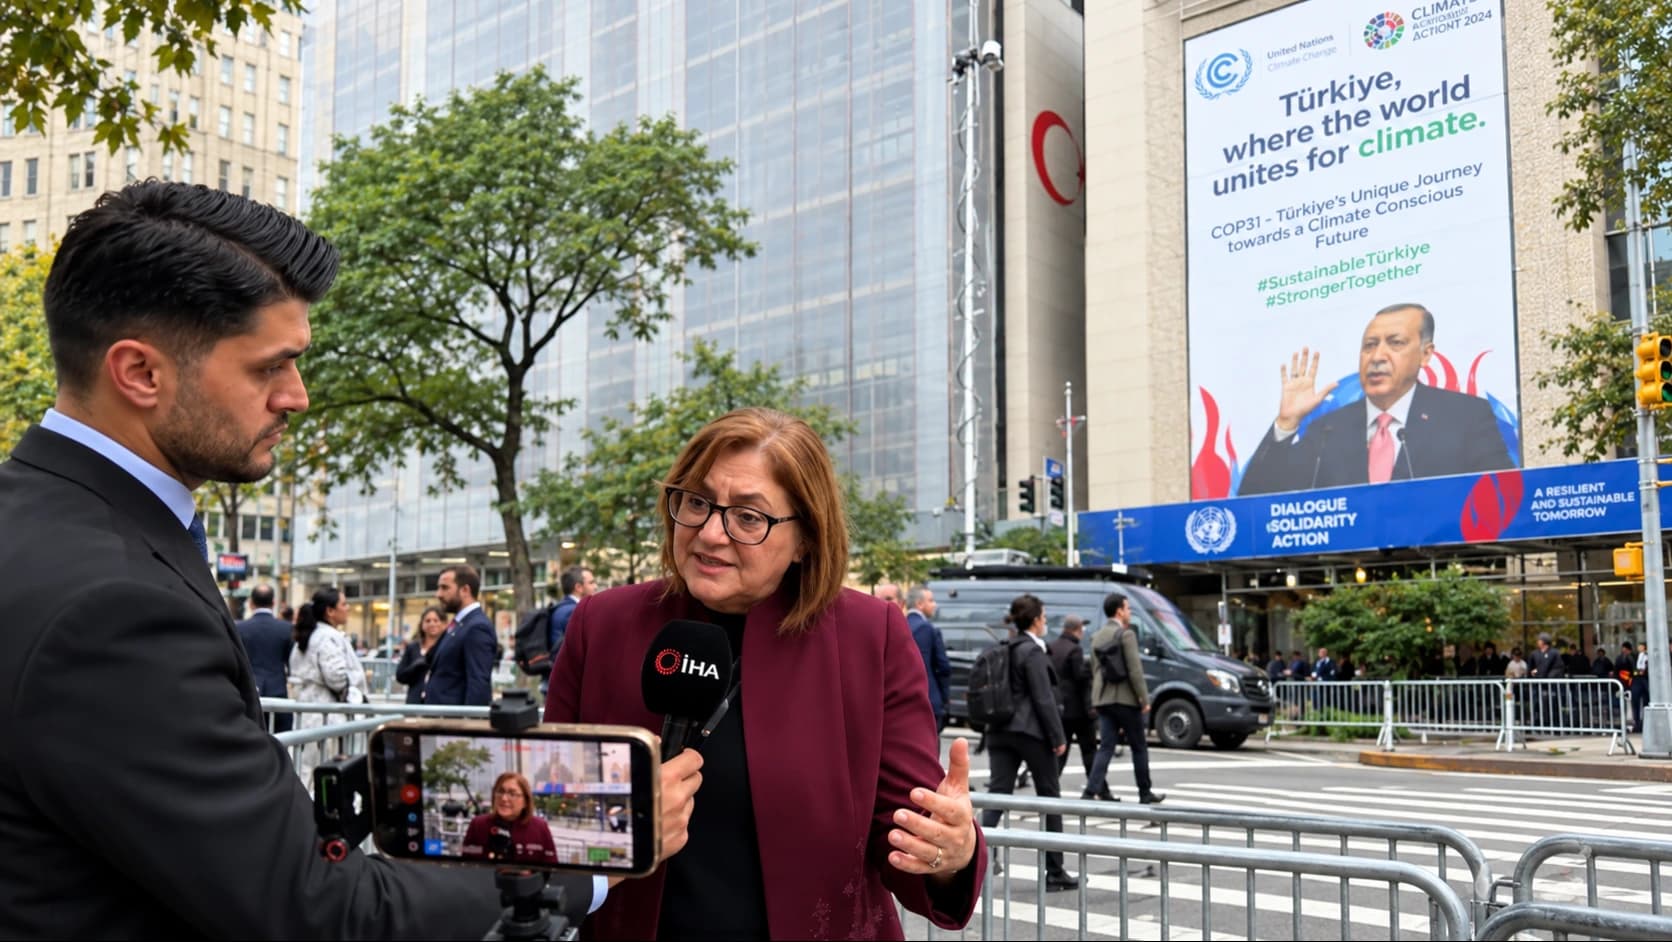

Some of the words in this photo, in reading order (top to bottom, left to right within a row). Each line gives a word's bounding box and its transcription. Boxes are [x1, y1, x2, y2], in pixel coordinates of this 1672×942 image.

[1464, 10, 1491, 26] 2024
[1267, 45, 1296, 59] United
[1299, 34, 1334, 50] Nations
[1279, 71, 1402, 117] Türkiye,
[1223, 124, 1314, 163] where
[1322, 110, 1371, 137] the
[1381, 75, 1471, 121] world
[1213, 158, 1298, 196] unites
[1306, 144, 1350, 171] for
[1358, 111, 1486, 157] climate.
[1211, 216, 1262, 239] COP31
[1276, 195, 1346, 223] Türkiye's
[1352, 180, 1409, 204] Unique
[1415, 162, 1484, 186] Journey
[1228, 229, 1290, 252] towards
[1295, 226, 1304, 236] a
[1308, 208, 1370, 232] Climate
[1375, 185, 1463, 216] Conscious
[1315, 226, 1369, 249] Future
[1258, 242, 1430, 292] #SustainableTürkiye
[1265, 263, 1422, 308] #StrongerTogether
[1531, 500, 1556, 510] AND
[1558, 492, 1634, 508] SUSTAINABLE
[1534, 488, 1543, 498] A
[1546, 482, 1605, 496] RESILIENT
[1270, 497, 1347, 517] DIALOGUE
[1533, 506, 1606, 522] TOMORROW
[1272, 531, 1329, 548] ACTION
